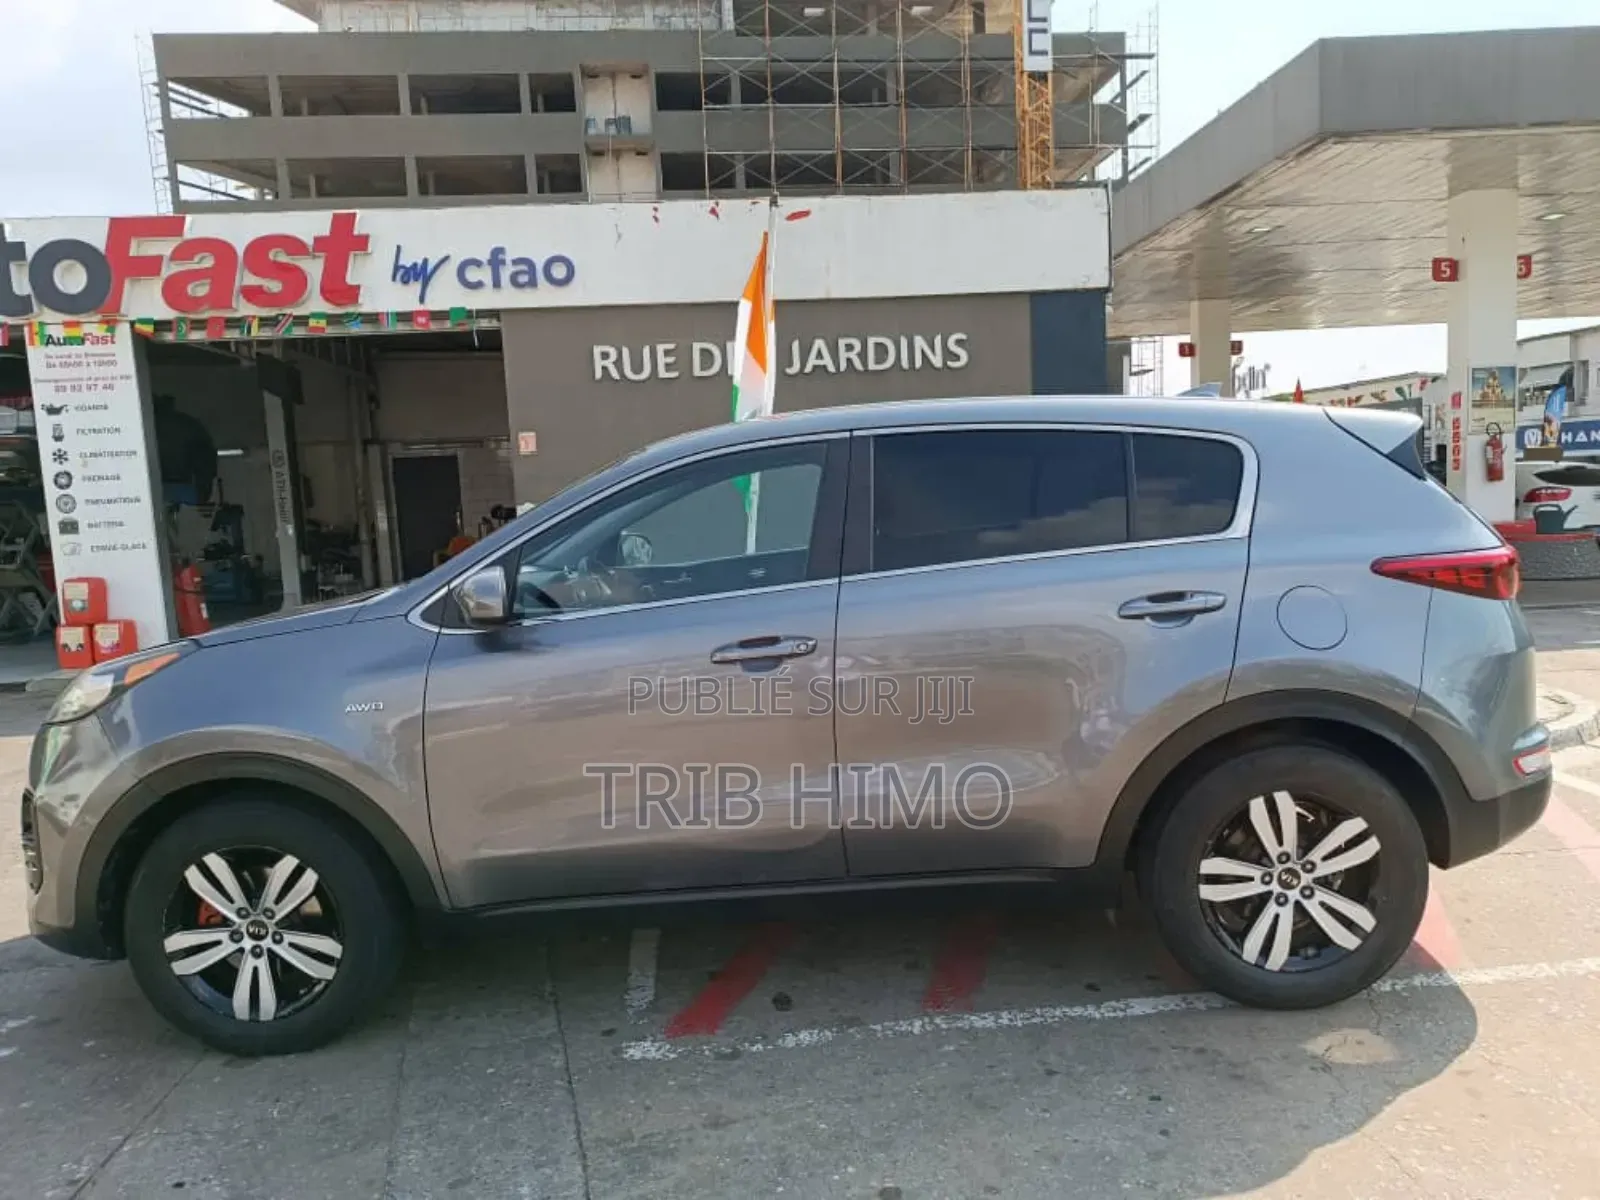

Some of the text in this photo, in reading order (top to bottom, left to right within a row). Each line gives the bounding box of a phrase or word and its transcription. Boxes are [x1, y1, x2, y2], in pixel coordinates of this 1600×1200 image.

[456, 246, 576, 291] cfao
[1440, 261, 1451, 278] 5
[45, 332, 116, 347] AuFast
[592, 343, 679, 381] RUE
[784, 332, 970, 376] JARDINS
[345, 700, 384, 713] AWD
